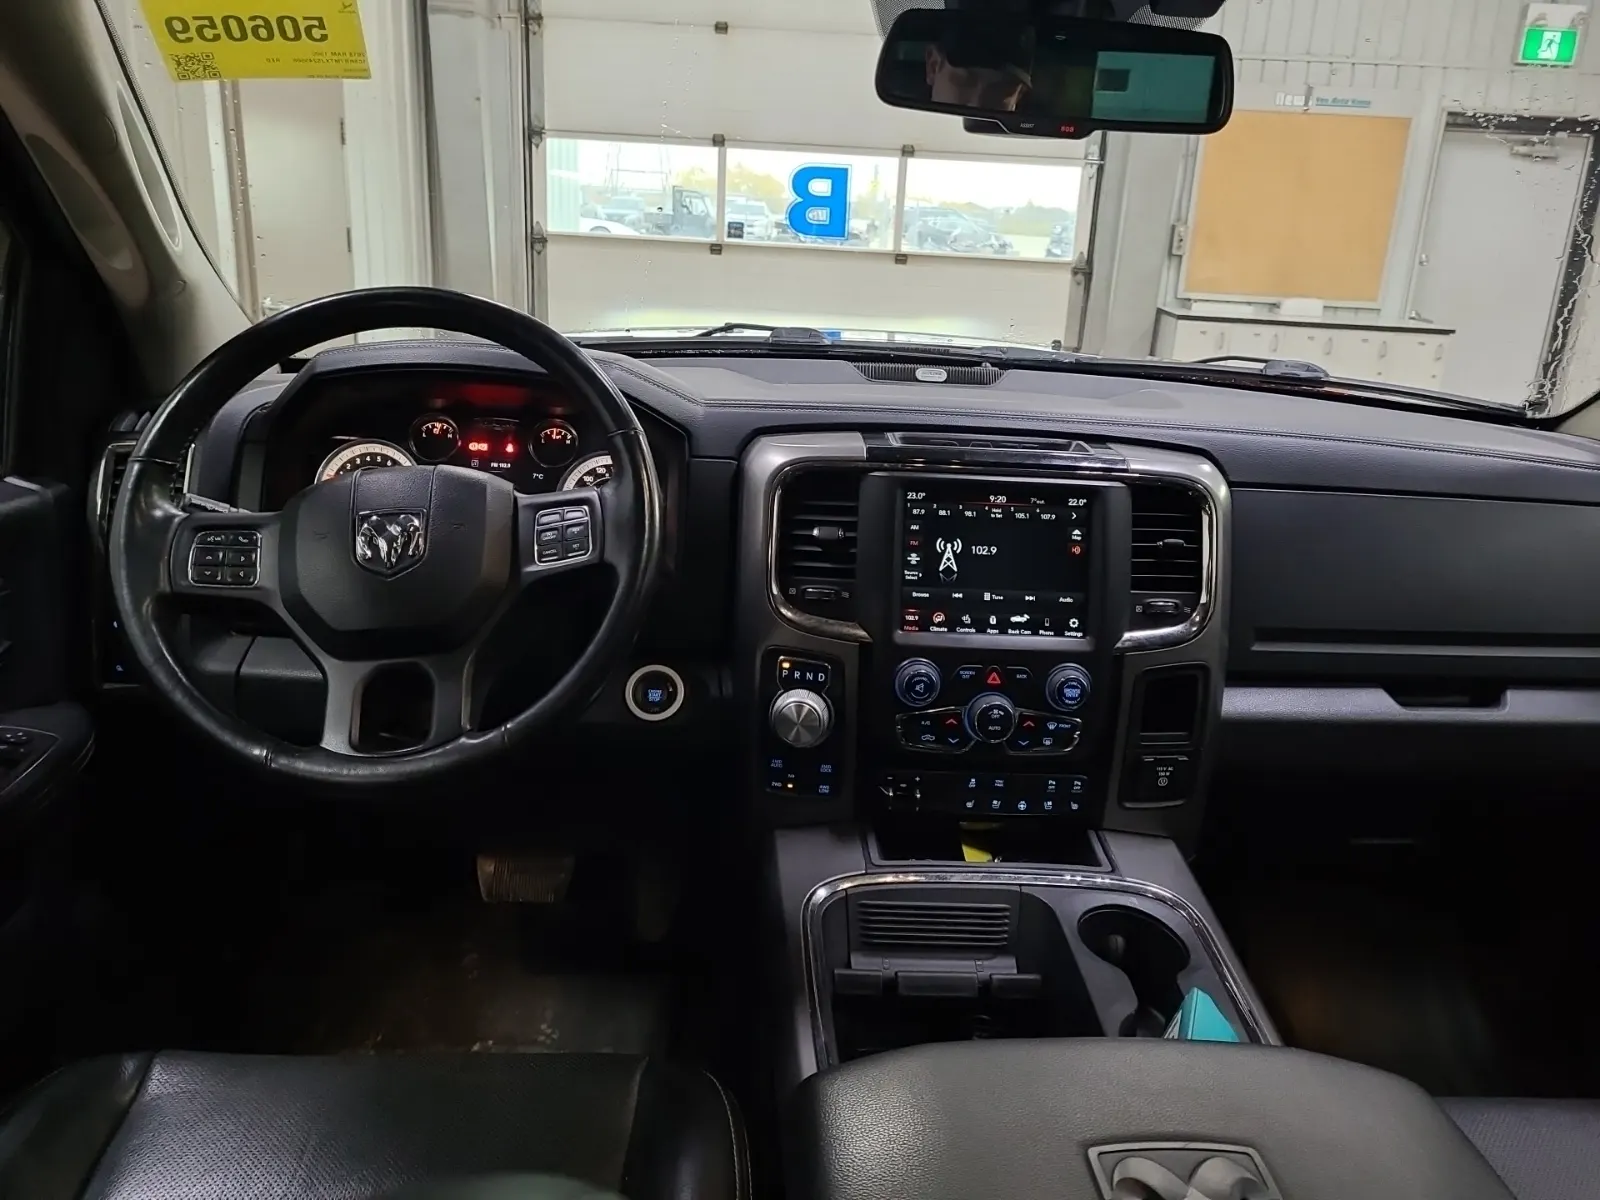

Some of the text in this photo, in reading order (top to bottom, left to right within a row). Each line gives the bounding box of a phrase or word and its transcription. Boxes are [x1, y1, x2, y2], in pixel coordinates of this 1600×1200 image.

[989, 495, 1007, 504] 9:20
[971, 545, 998, 555] 102.9
[782, 669, 826, 682] P R N D
